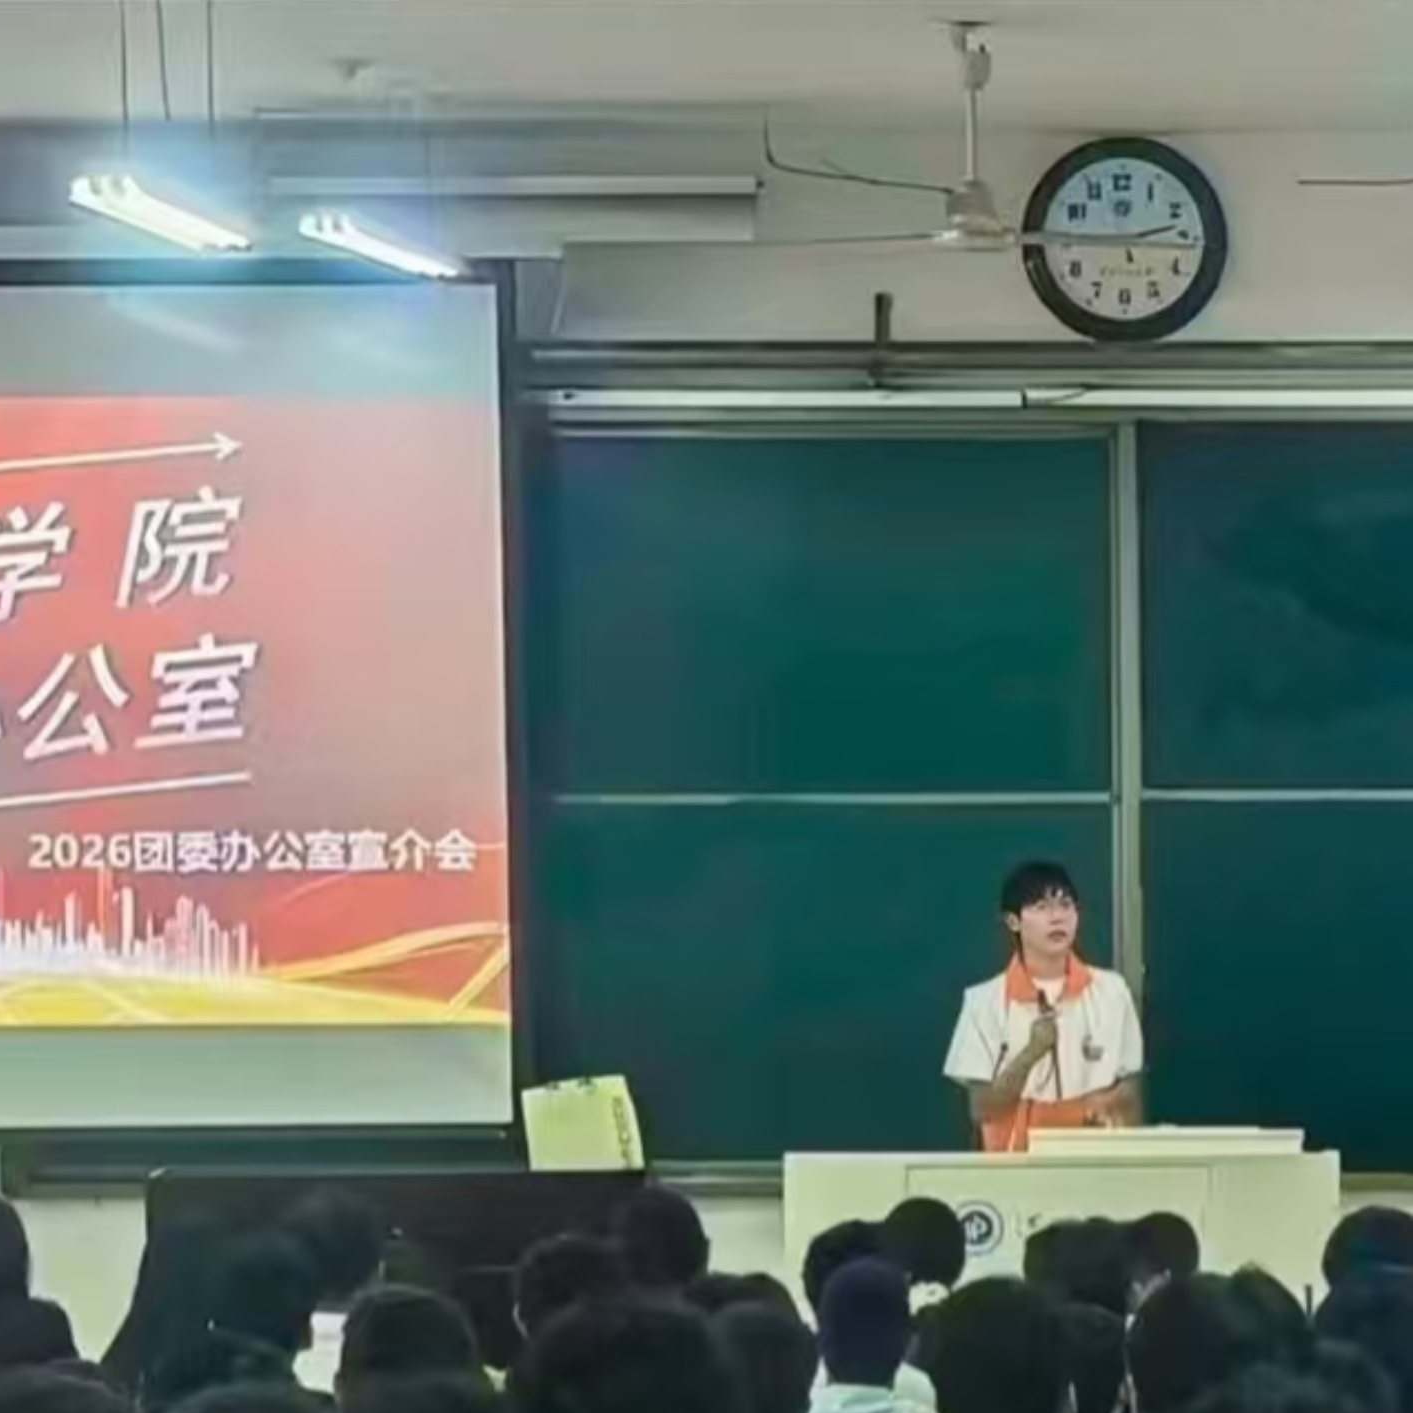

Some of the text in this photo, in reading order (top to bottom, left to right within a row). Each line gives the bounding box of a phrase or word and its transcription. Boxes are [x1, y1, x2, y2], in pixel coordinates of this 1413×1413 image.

[28, 828, 478, 873] 2026团委办公室宣介会
